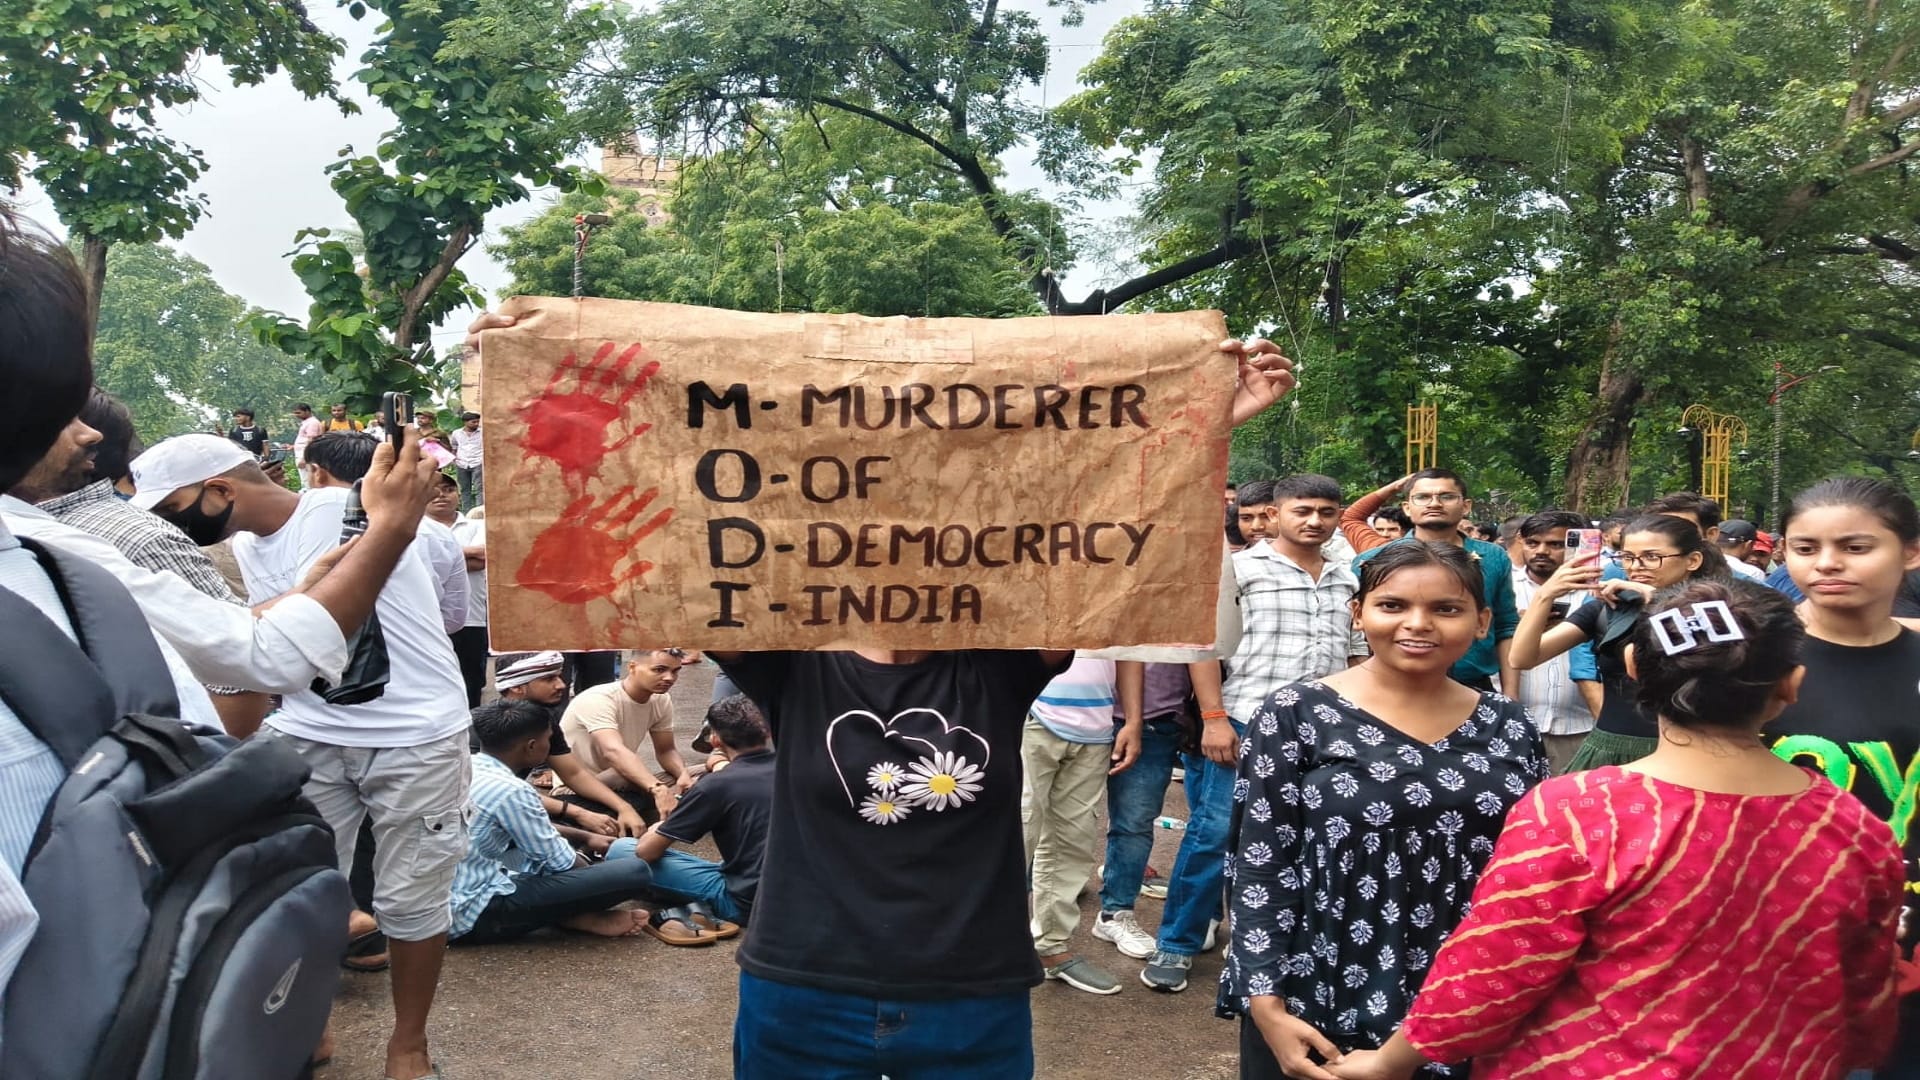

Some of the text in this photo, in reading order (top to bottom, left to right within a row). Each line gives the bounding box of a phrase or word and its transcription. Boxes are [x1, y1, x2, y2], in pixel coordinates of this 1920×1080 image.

[800, 383, 1150, 432] MURDERER
[800, 455, 893, 504] OF
[807, 521, 1156, 570] DEMOCRACY
[800, 583, 984, 627] INDIA
